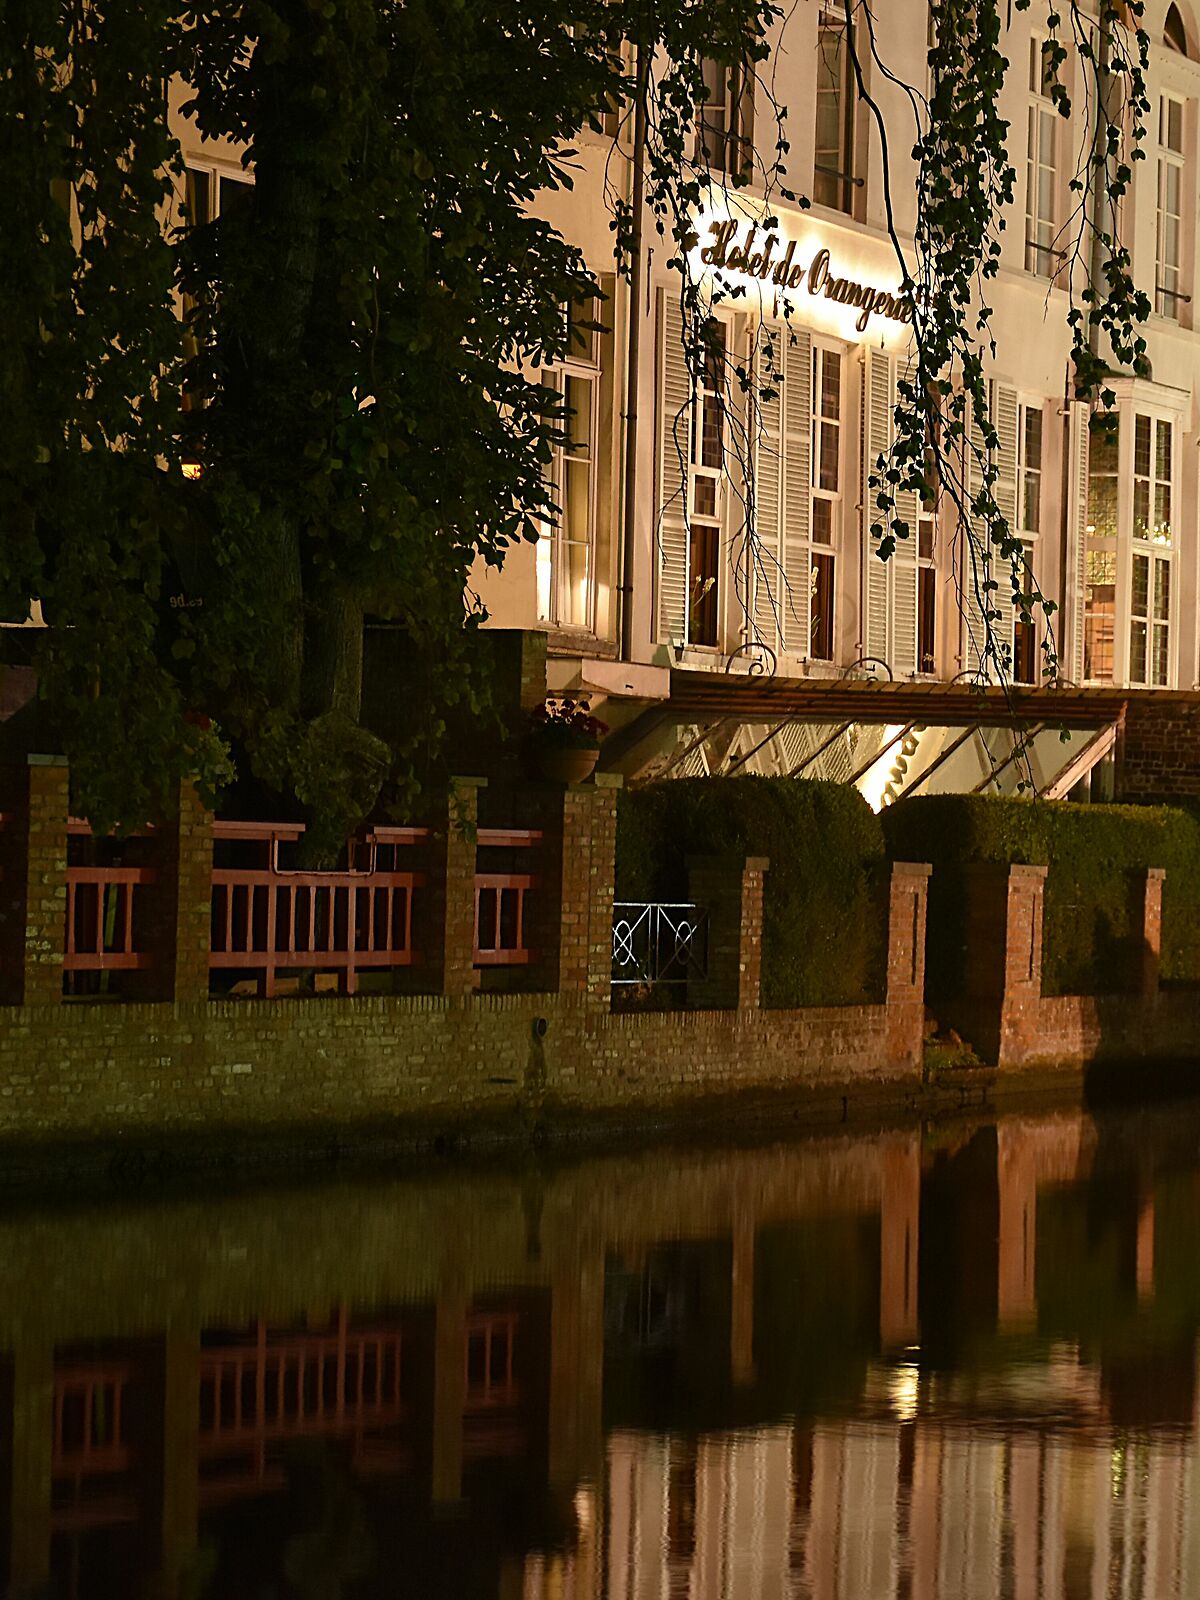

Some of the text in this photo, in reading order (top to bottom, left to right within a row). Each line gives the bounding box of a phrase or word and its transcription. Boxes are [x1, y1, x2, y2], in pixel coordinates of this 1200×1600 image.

[701, 219, 914, 332] Hotel de Orangerie
